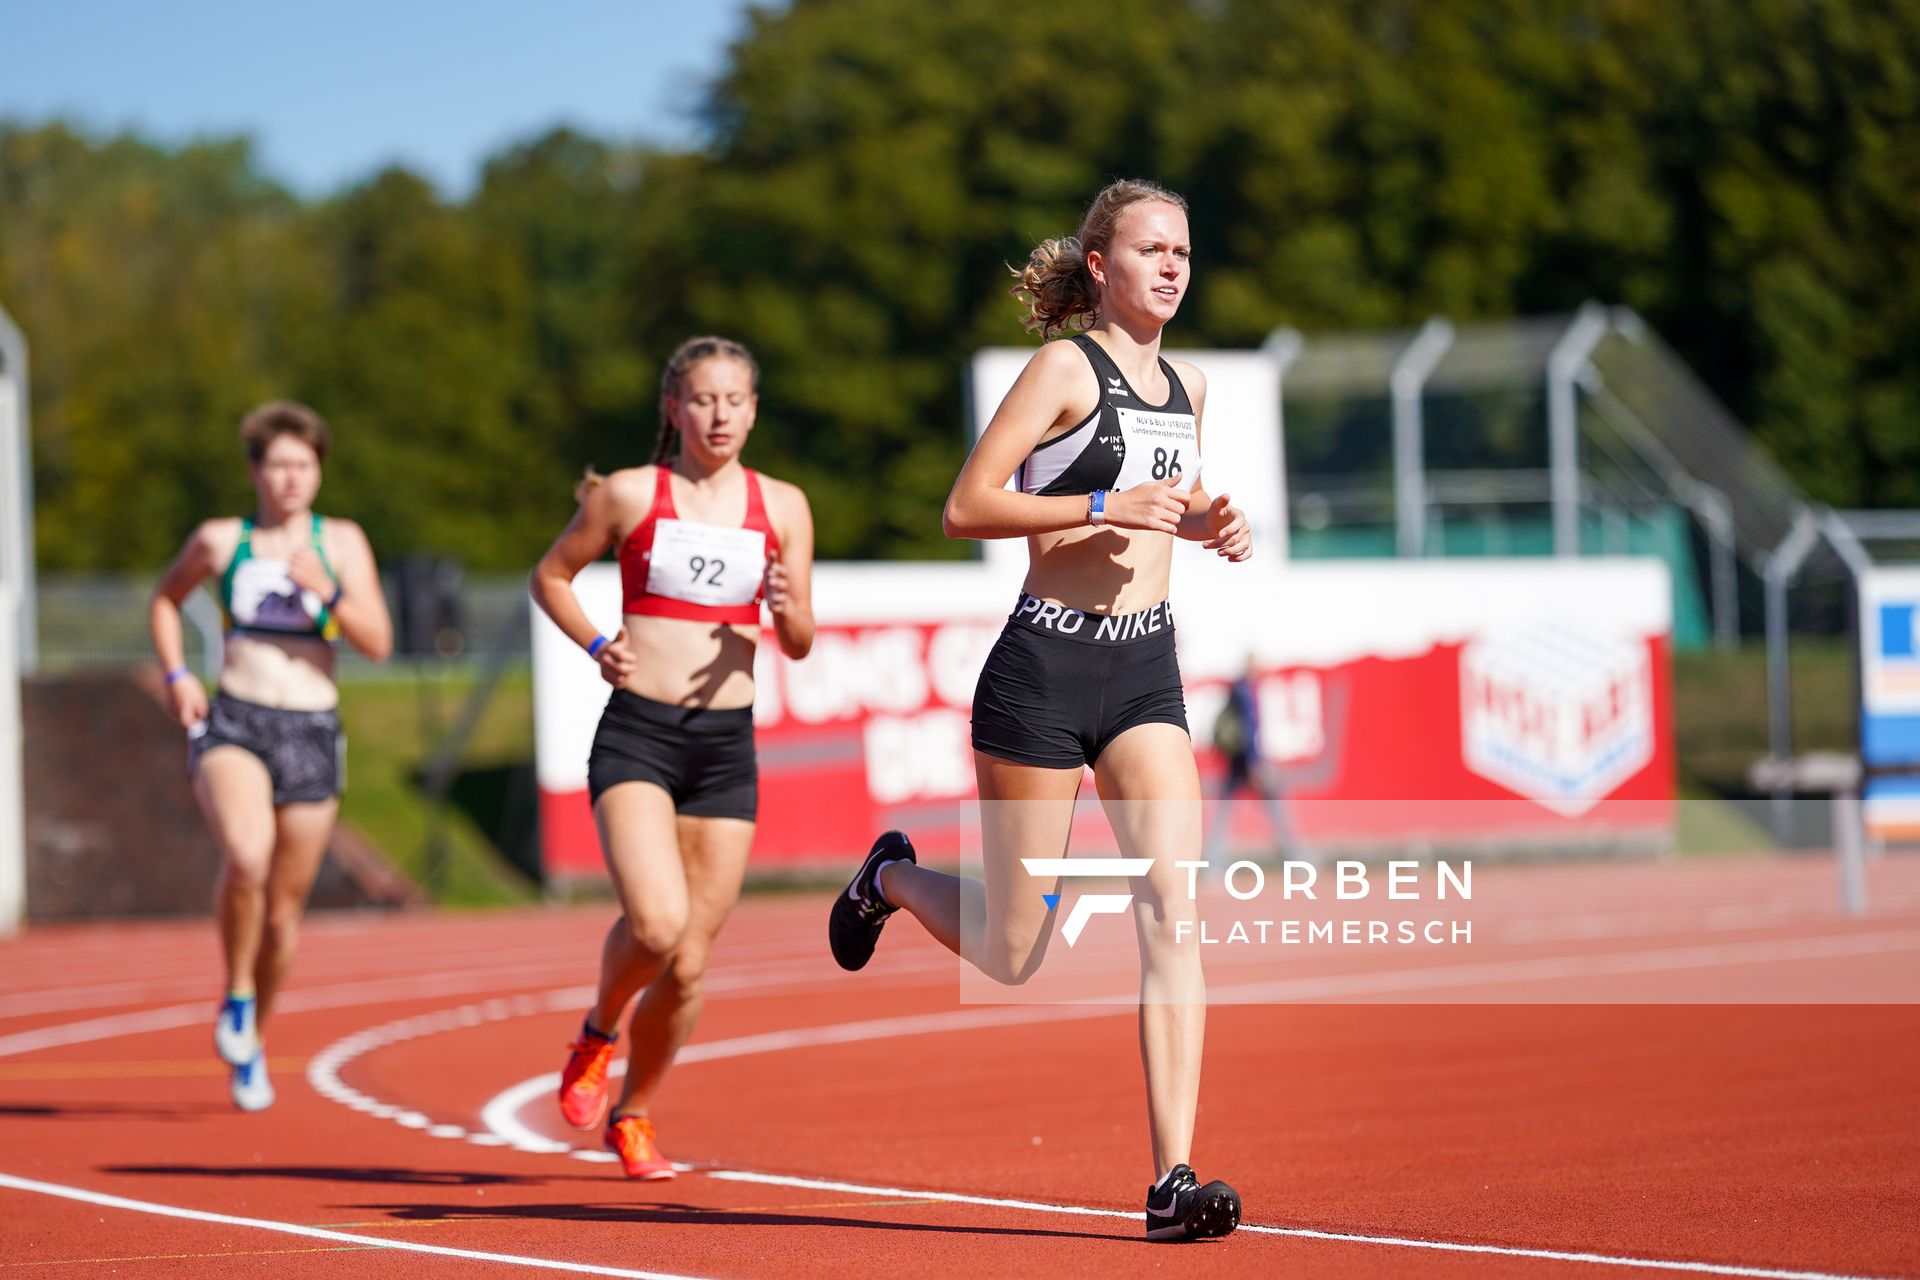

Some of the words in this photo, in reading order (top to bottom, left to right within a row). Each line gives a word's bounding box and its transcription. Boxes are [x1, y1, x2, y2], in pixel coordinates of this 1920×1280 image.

[1151, 447, 1182, 481] 86
[689, 556, 725, 587] 92
[1016, 595, 1085, 634] PRO
[1094, 603, 1161, 641] NIKE
